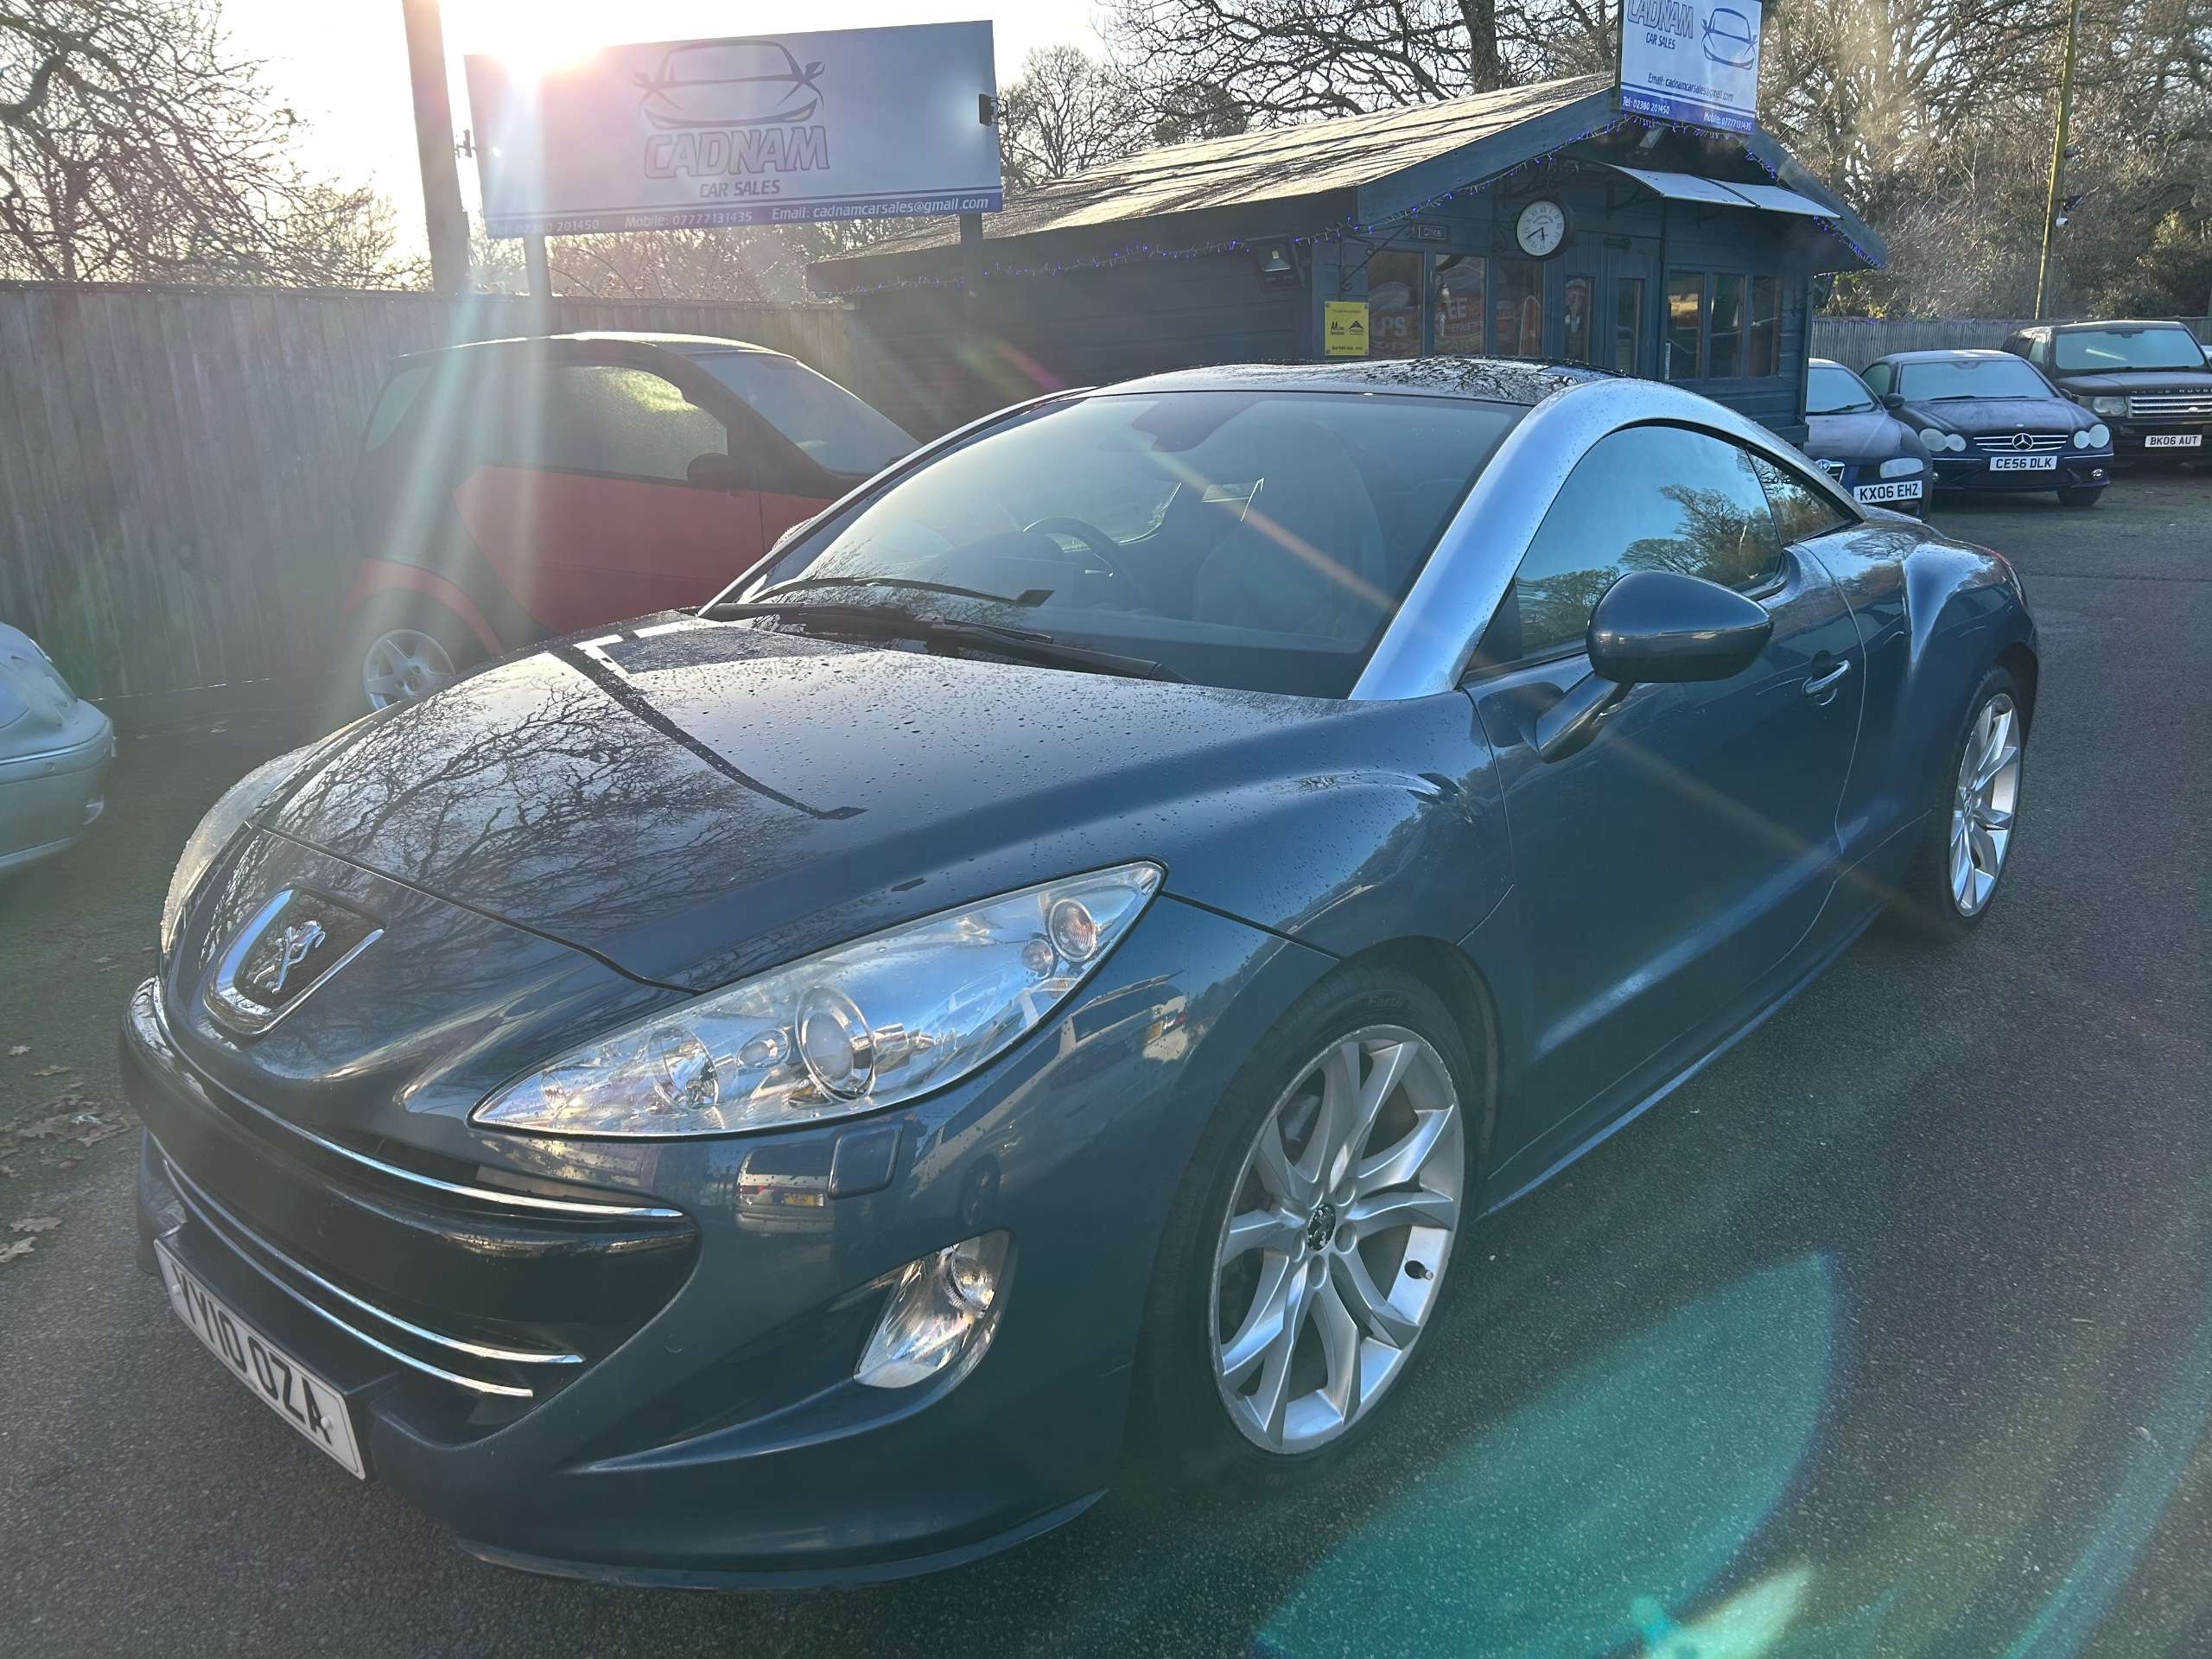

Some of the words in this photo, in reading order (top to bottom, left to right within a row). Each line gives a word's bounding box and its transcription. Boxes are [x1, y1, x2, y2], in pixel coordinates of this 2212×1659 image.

[1626, 0, 1694, 40] CADNAM
[1645, 32, 1657, 46] CAR
[1658, 35, 1675, 49] SALES
[1632, 100, 1650, 111] 02380
[1651, 103, 1670, 115] 201450
[644, 125, 830, 179] CADNAM
[700, 182, 728, 198] CAR
[733, 180, 781, 196] SALES
[772, 207, 810, 220] Email:
[813, 197, 988, 218] cadnamcarsales@gmail.com
[556, 219, 600, 232] 201450
[625, 214, 668, 229] Mobile:
[672, 211, 753, 226] 07777131435
[2149, 436, 2176, 446] BK06
[2178, 435, 2198, 445] AUT
[1995, 458, 2027, 469] CE56
[2029, 457, 2052, 468] DLK
[1859, 485, 1894, 501] KX06
[1897, 482, 1919, 498] EHZ
[171, 1262, 247, 1373] YY10
